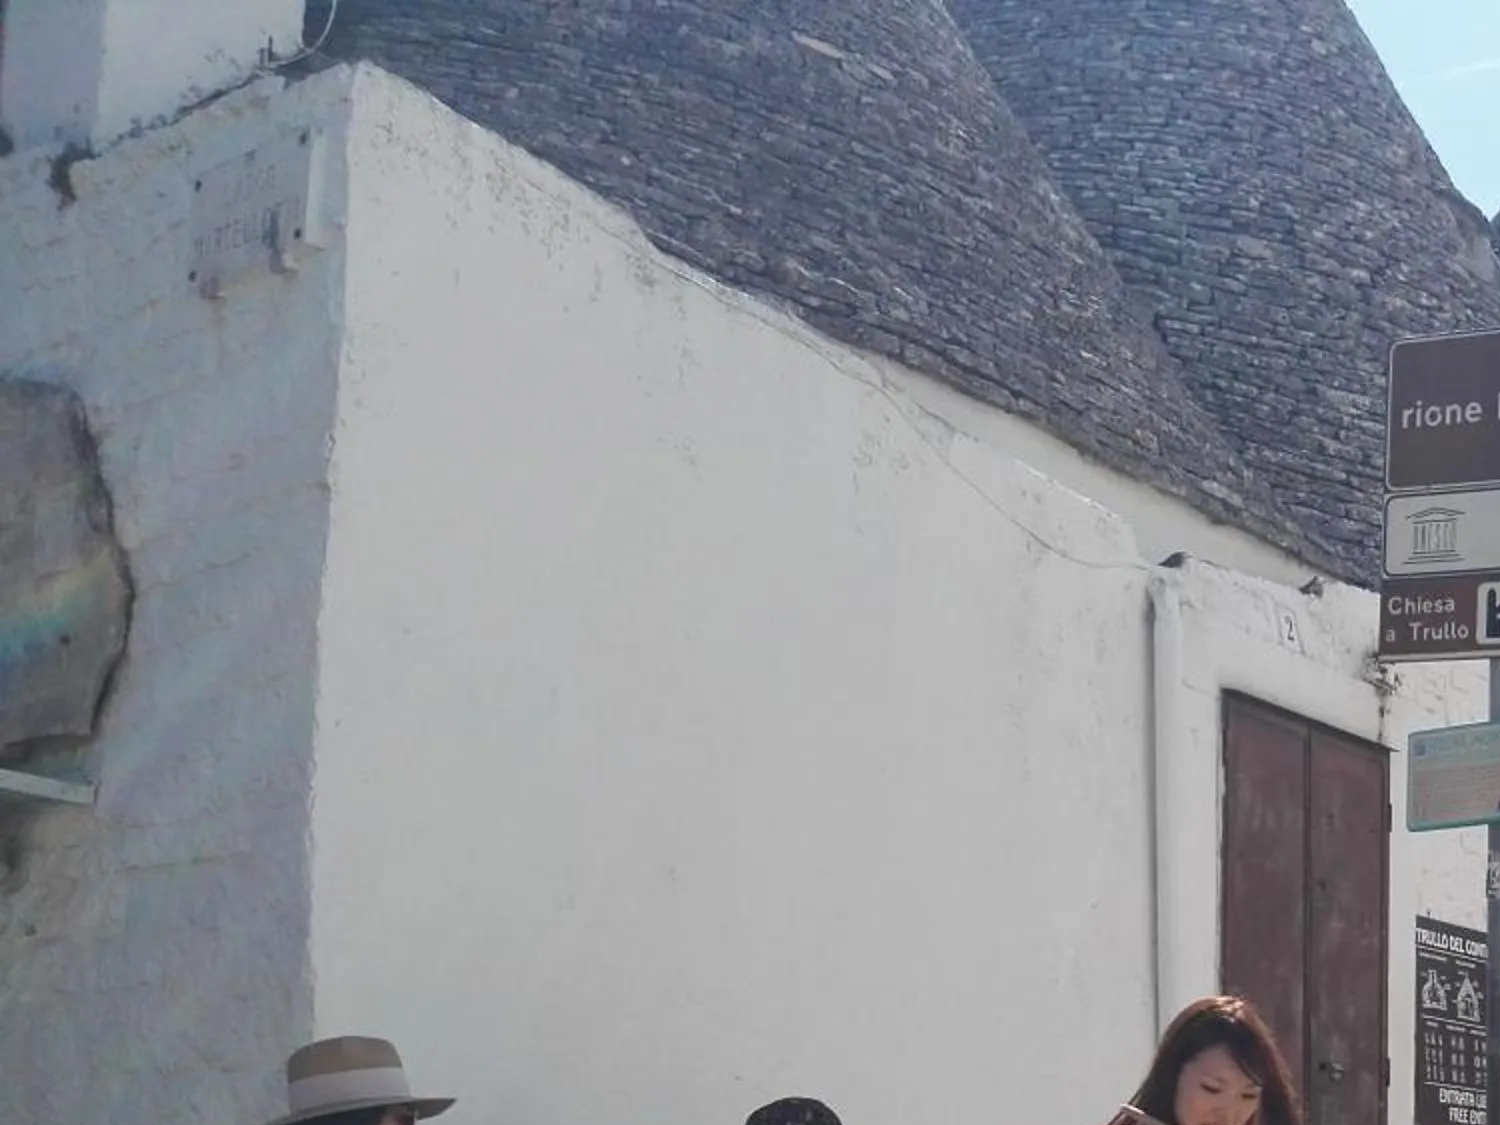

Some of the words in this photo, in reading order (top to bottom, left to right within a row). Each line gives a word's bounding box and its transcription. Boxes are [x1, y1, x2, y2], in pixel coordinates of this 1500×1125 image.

[1401, 399, 1482, 429] rione
[1387, 596, 1456, 616] Chiesa
[1385, 630, 1395, 642] a
[1409, 622, 1469, 641] Trullo
